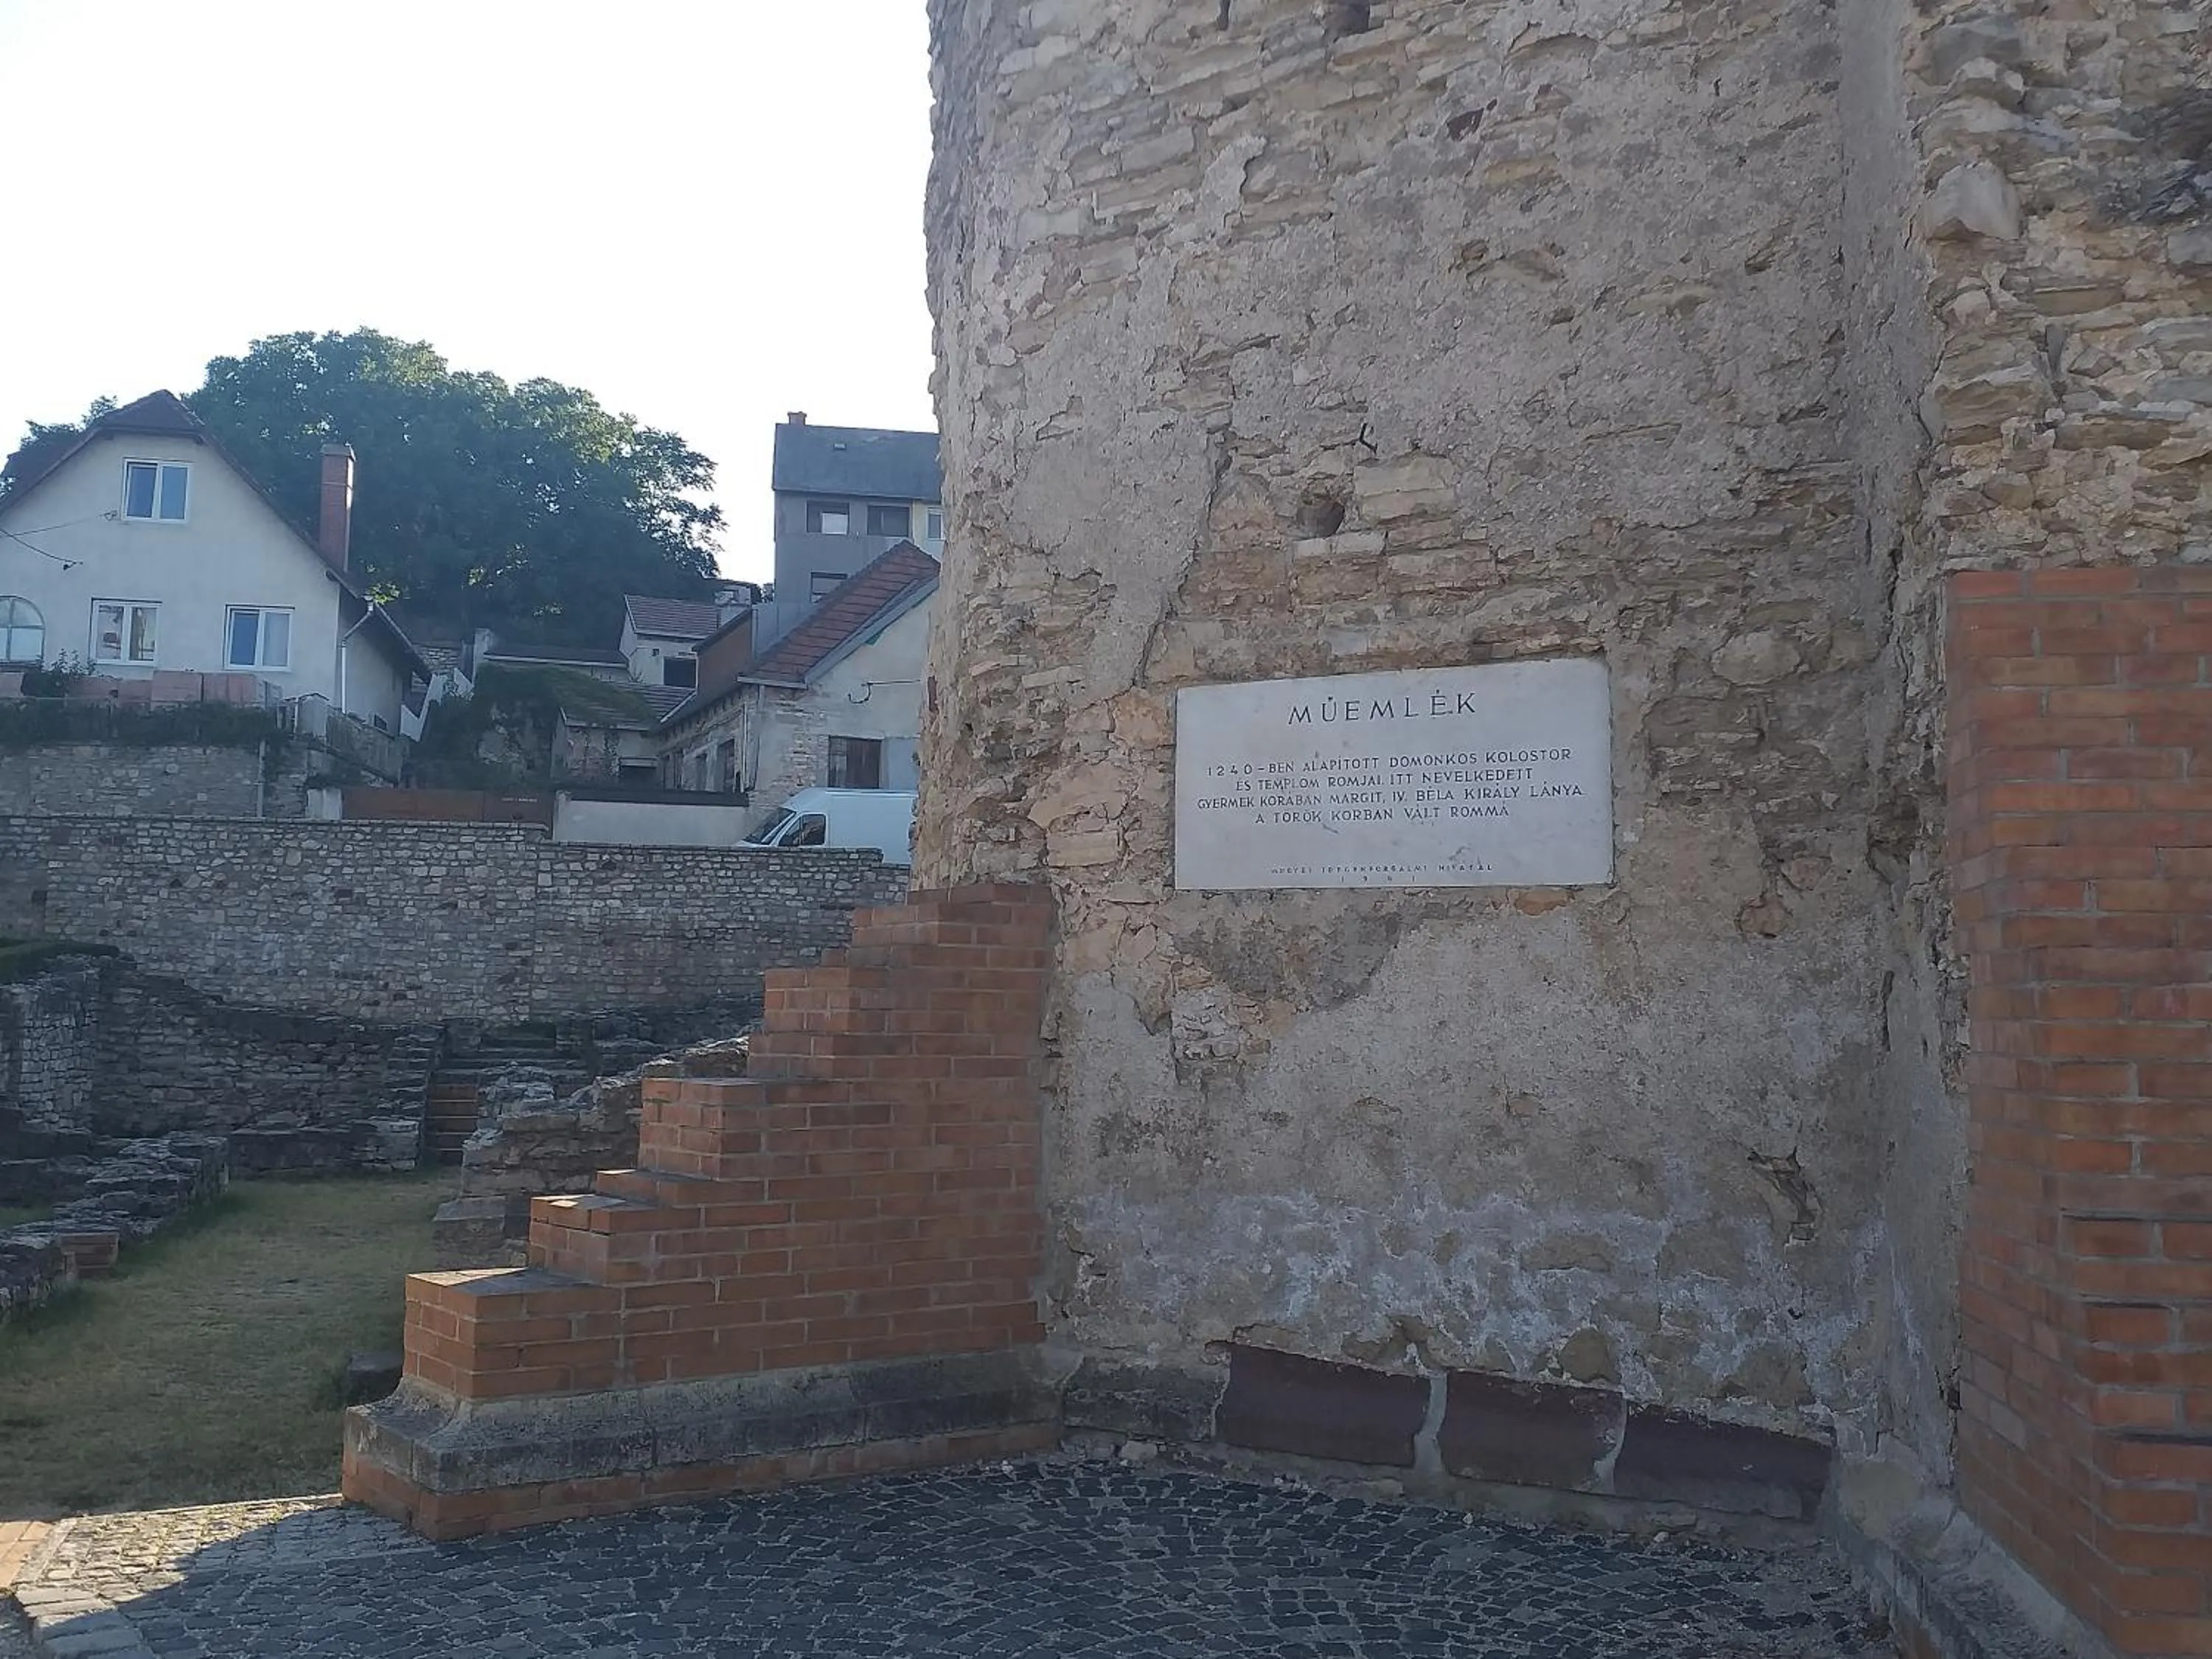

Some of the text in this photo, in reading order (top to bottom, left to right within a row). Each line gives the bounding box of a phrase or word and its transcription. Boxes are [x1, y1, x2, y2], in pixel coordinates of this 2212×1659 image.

[1390, 753, 1477, 768] DOMONKOS
[1486, 748, 1571, 763] KOLOSTOR
[1258, 778, 1320, 790] TEMPLOM
[1390, 773, 1413, 785] ITT
[1422, 768, 1533, 784] NEVELKEDETT
[1197, 796, 1255, 810] GYERMEK
[1416, 785, 1455, 801] BÉLA
[1464, 783, 1520, 800] KIRÁLY
[1255, 813, 1265, 824] A
[1330, 807, 1394, 821] KORBAN
